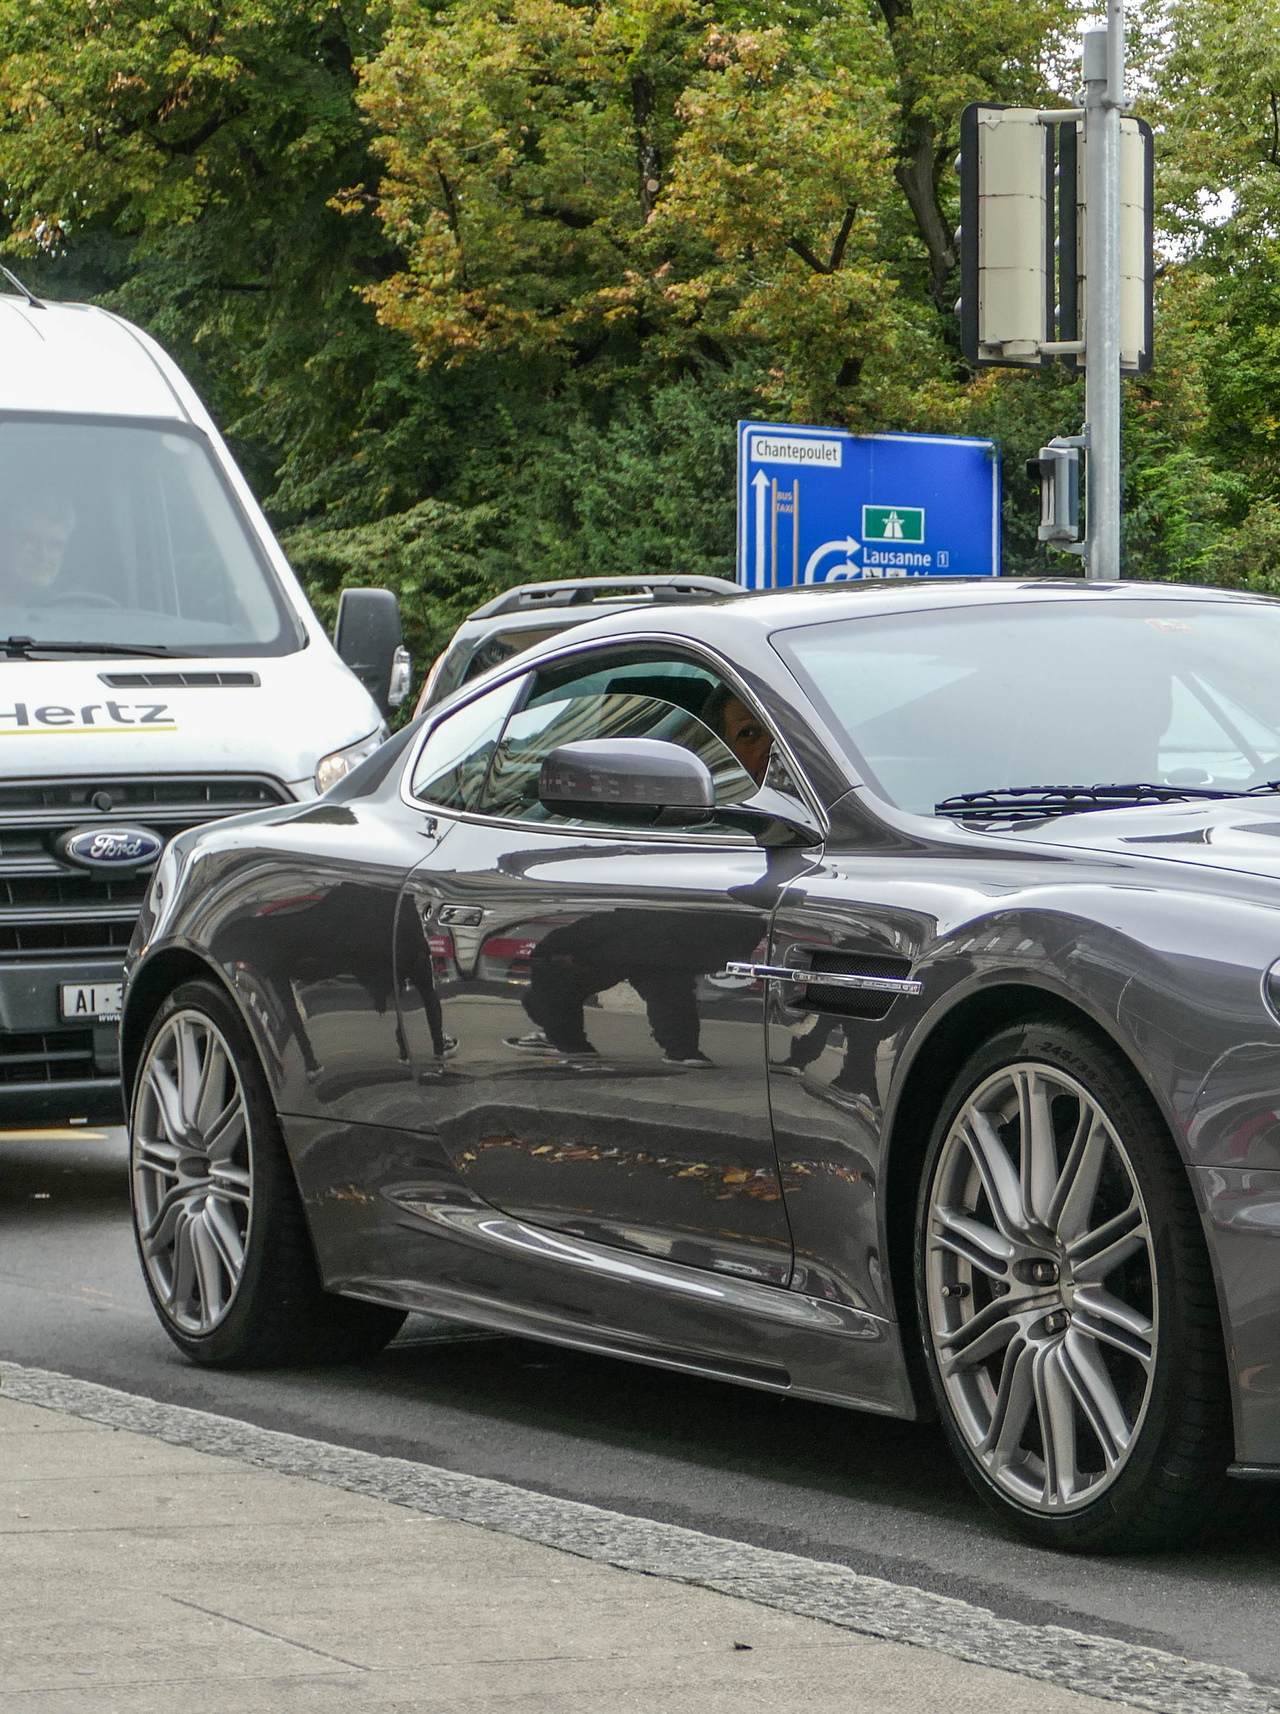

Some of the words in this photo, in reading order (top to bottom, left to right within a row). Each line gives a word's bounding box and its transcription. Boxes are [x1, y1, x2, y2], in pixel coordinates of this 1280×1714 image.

[756, 440, 837, 462] Chantepoulet
[777, 491, 792, 500] BUS
[777, 504, 793, 513] TAXI
[863, 547, 932, 567] Lausanne
[90, 834, 141, 858] Ford
